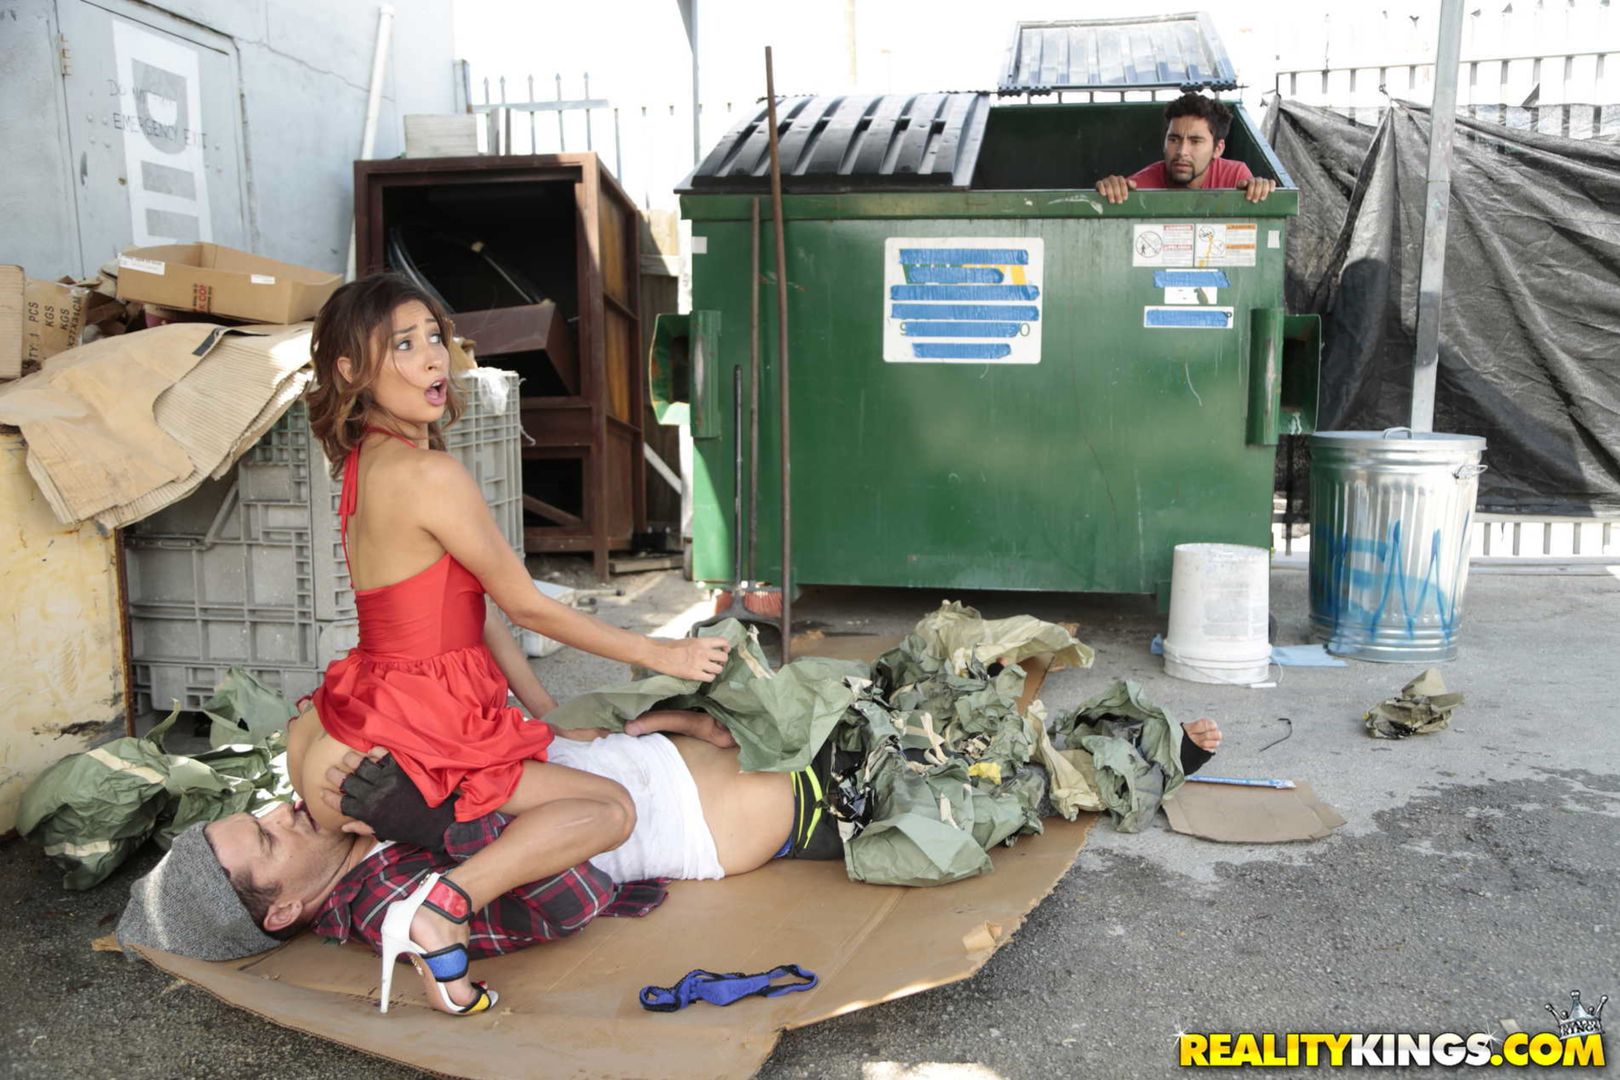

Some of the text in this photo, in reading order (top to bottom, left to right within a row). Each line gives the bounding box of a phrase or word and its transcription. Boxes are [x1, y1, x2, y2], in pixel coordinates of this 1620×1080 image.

[28, 301, 40, 323] PCS
[44, 305, 55, 328] KGS
[59, 308, 70, 331] KGS
